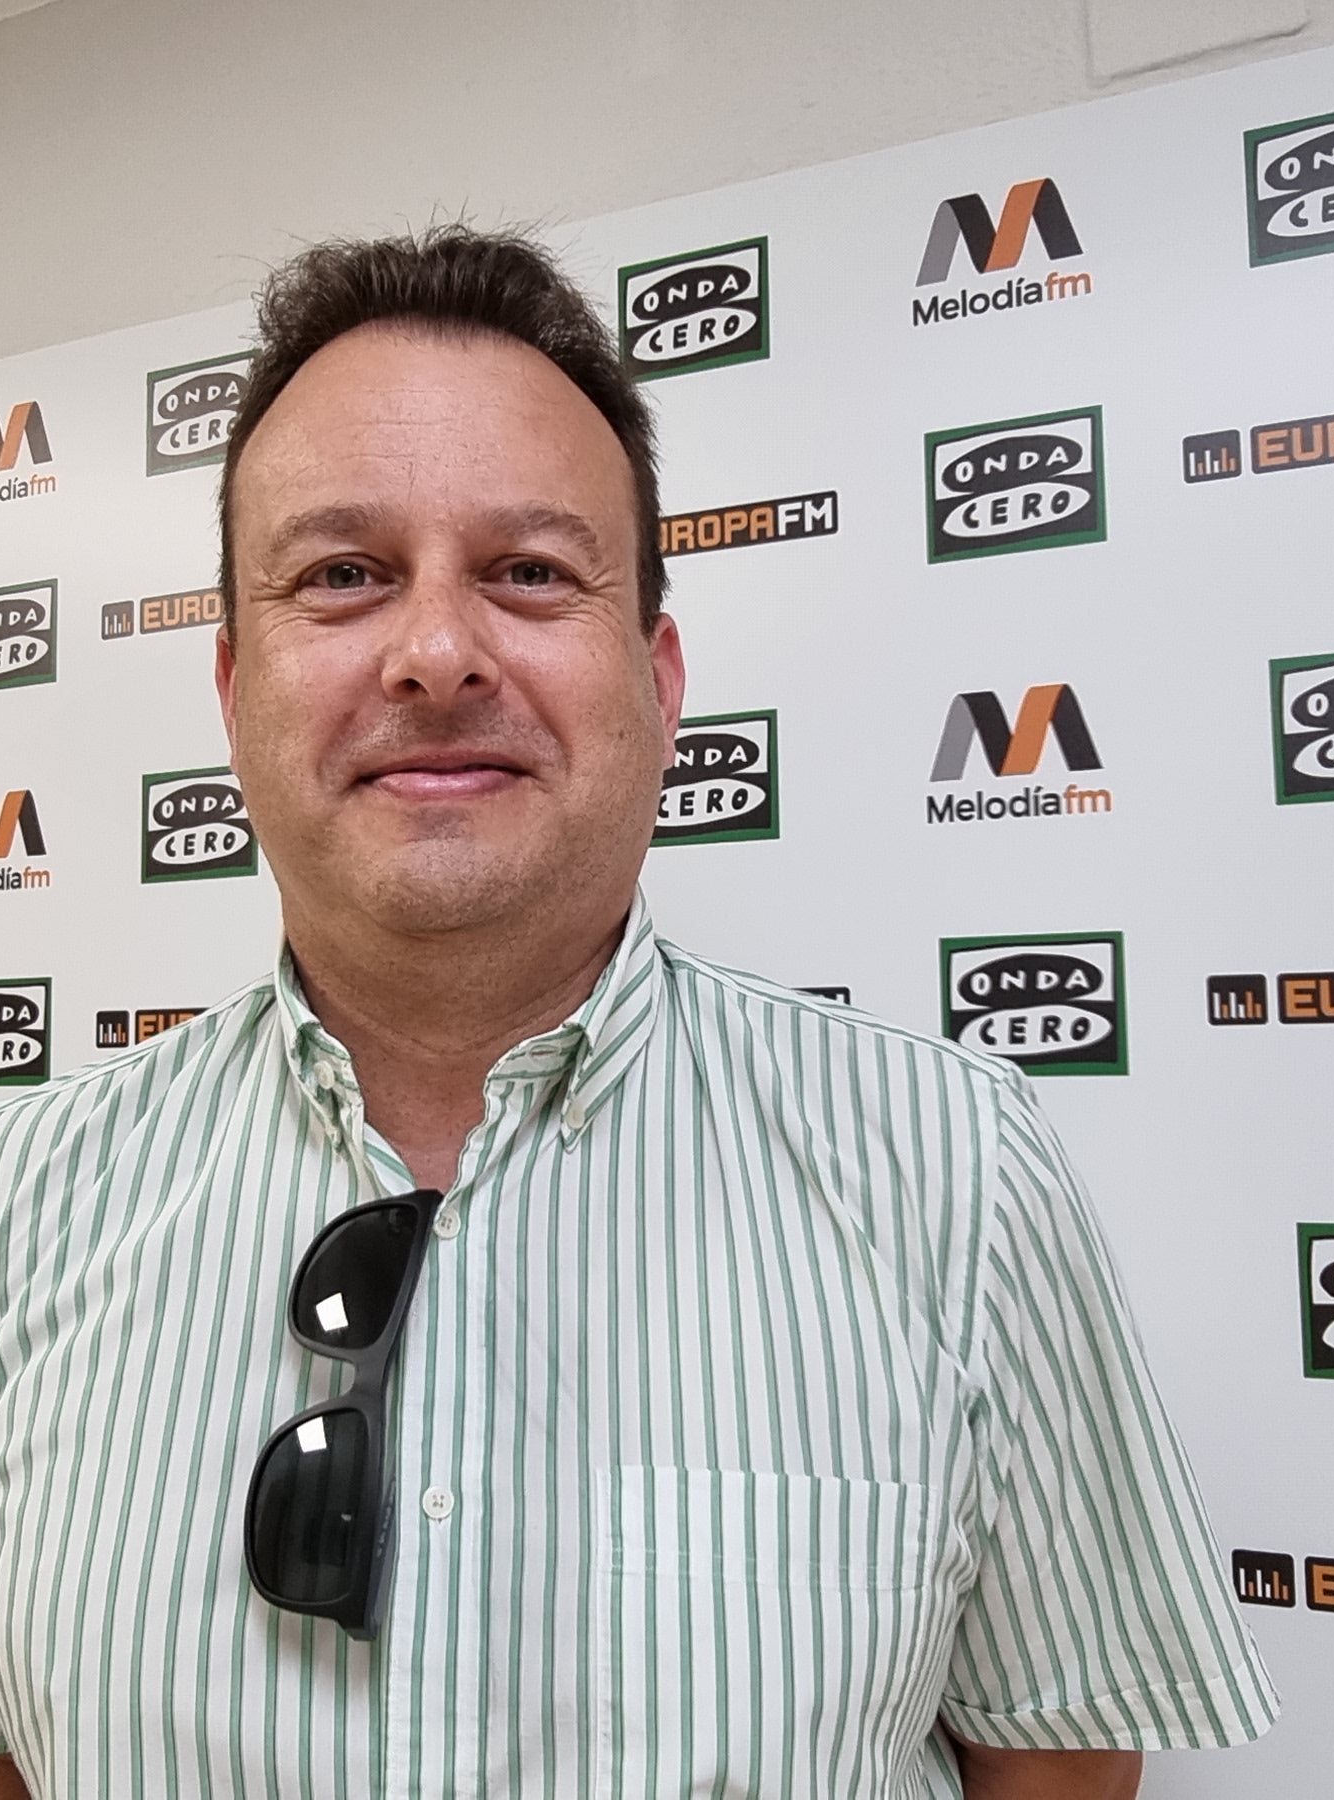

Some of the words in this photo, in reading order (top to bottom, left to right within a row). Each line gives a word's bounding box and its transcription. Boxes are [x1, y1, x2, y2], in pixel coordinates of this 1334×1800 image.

[642, 274, 738, 312] ONDA
[912, 272, 1091, 326] Melodíafm
[648, 312, 741, 352] CERO
[166, 380, 239, 412] ONDA
[955, 446, 1069, 483] ONDA
[660, 498, 832, 552] ROPAFM
[962, 490, 1071, 529] CERO
[144, 593, 221, 629] EURO
[674, 745, 747, 768] NDA
[161, 793, 236, 819] ONDA
[926, 784, 1112, 824] Melodíafm
[165, 832, 235, 858] CERO
[971, 969, 1090, 996] ONDA
[979, 1017, 1091, 1045] CERO
